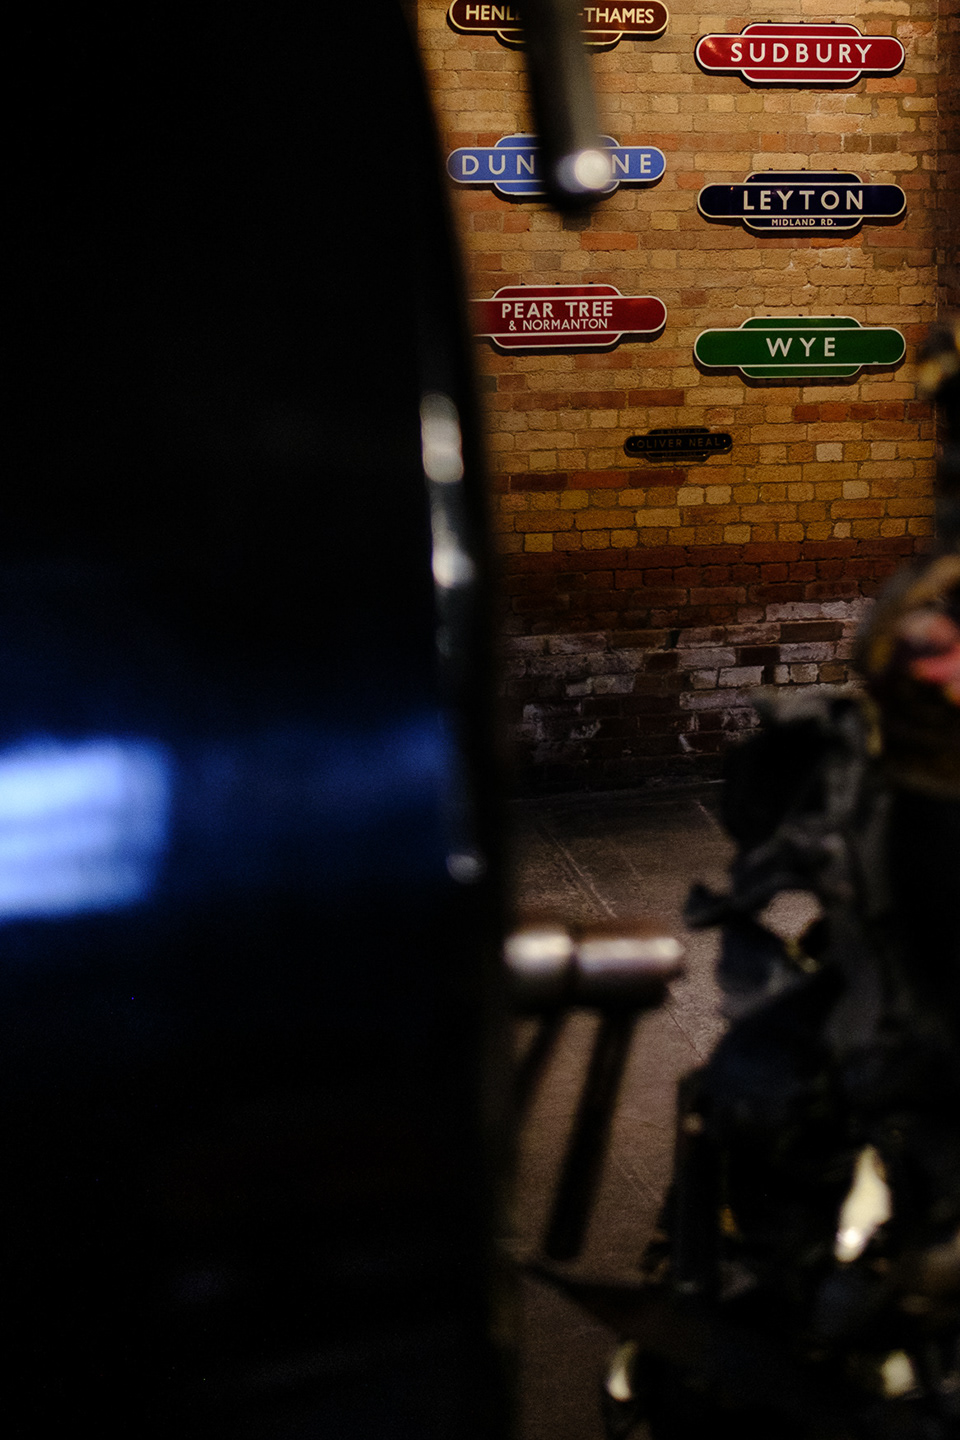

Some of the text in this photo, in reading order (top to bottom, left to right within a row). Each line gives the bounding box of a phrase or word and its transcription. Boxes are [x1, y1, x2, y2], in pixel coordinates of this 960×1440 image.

[730, 42, 872, 63] SUDBURY
[461, 153, 652, 175] DUNNE
[743, 190, 863, 210] LEYTON
[771, 218, 837, 227] MIDLAND RD.
[501, 301, 614, 319] PEAR TREE
[508, 318, 608, 331] & NORMANTON
[766, 337, 836, 358] WYE
[636, 436, 721, 449] OLIVER NEAL
